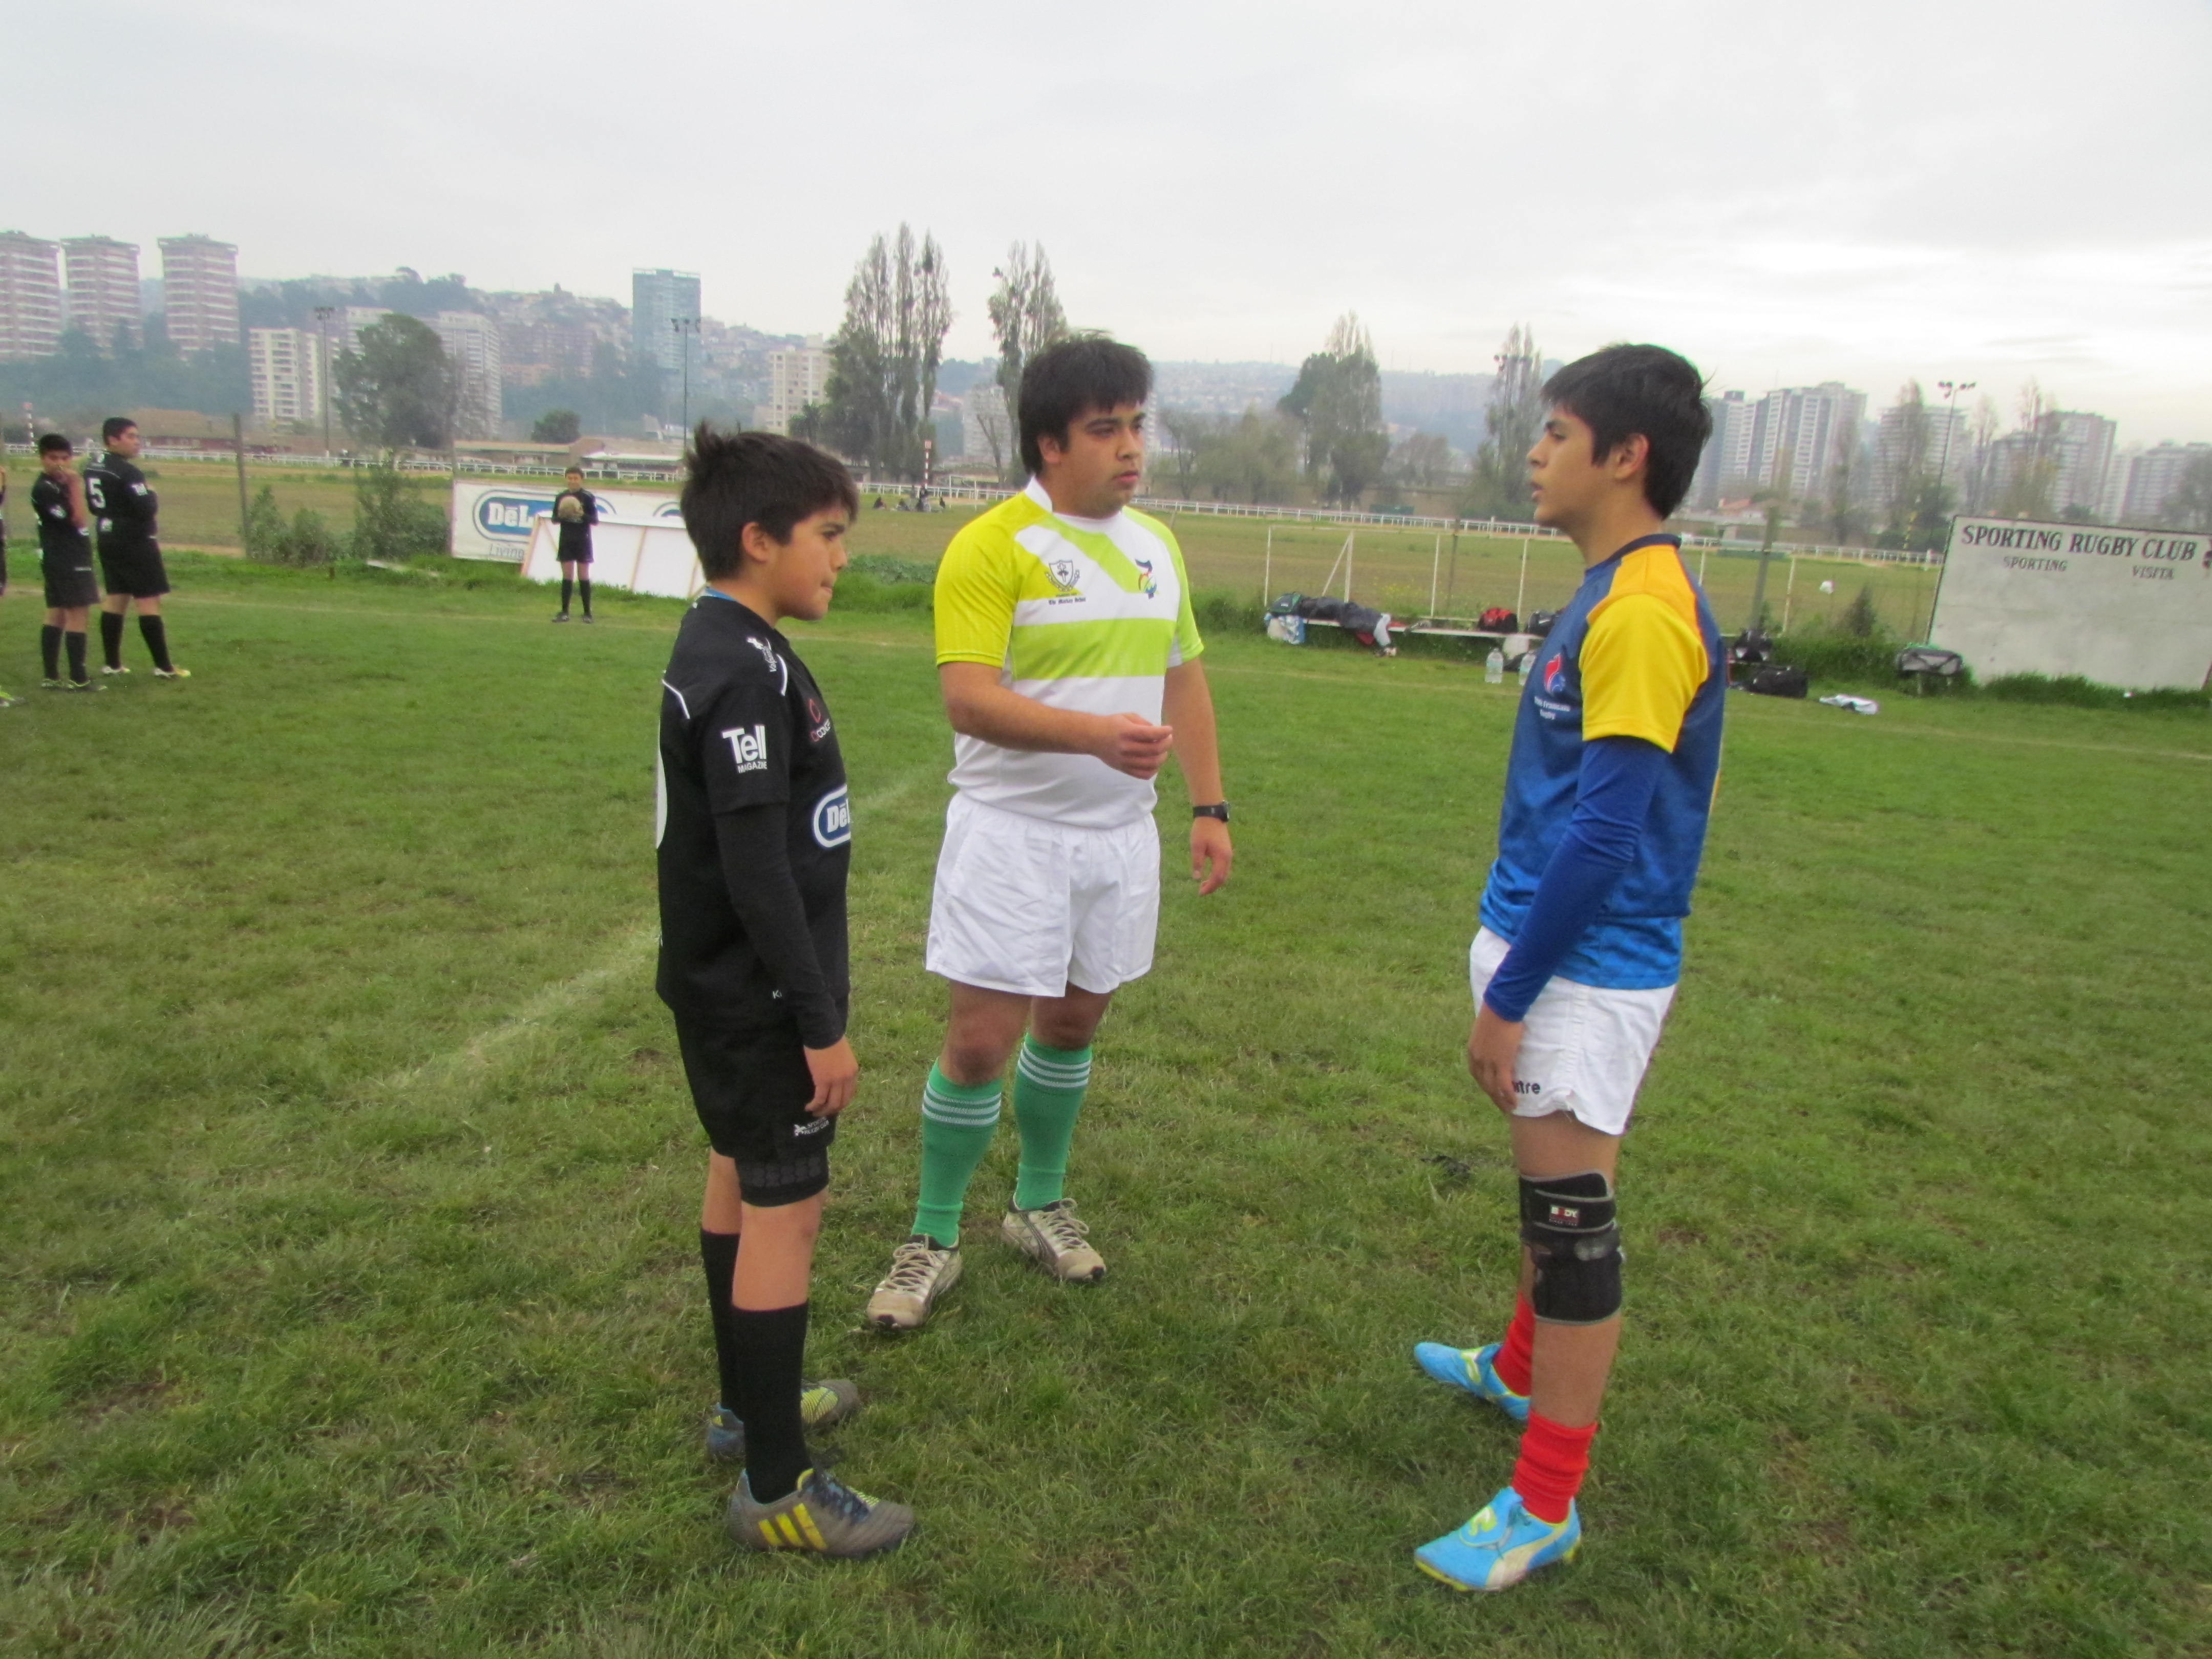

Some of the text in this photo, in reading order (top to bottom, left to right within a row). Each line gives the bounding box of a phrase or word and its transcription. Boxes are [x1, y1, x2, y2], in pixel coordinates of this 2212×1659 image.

[87, 477, 107, 508] 5
[1962, 524, 2198, 561] SPORTING RUGBY CLUB
[2003, 556, 2068, 572] SPORTING
[722, 725, 767, 764] Tell
[737, 760, 768, 774] MAGAZINE
